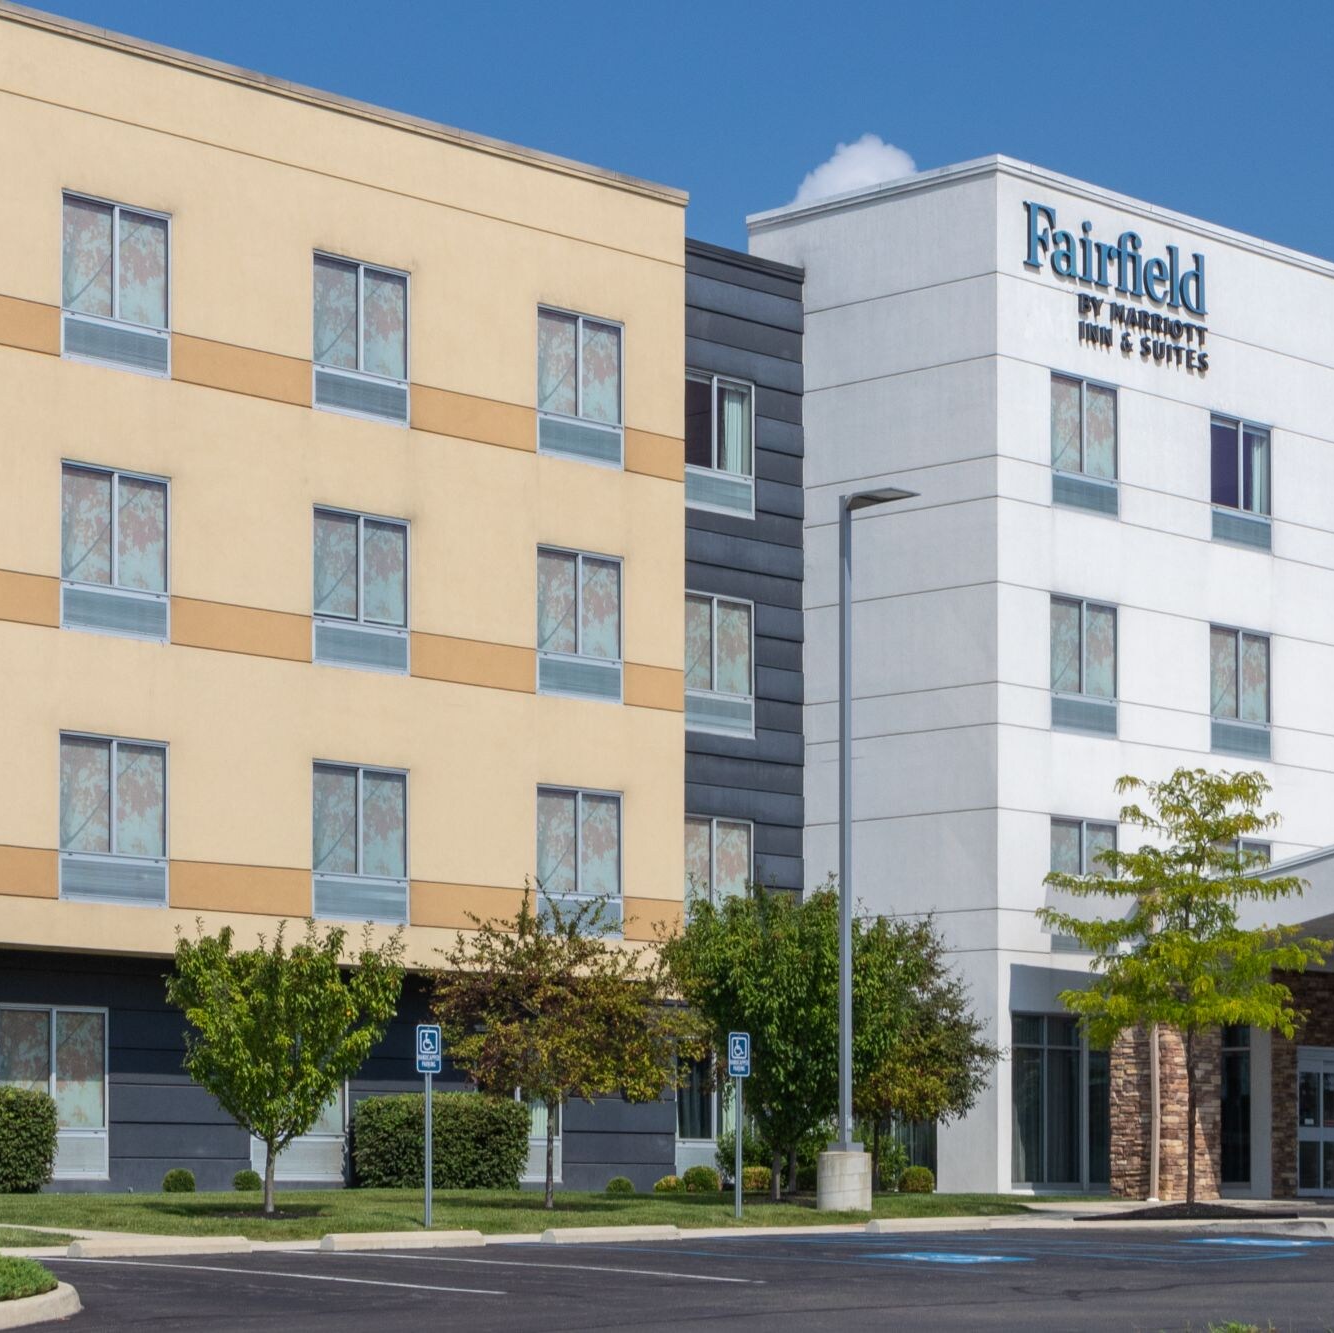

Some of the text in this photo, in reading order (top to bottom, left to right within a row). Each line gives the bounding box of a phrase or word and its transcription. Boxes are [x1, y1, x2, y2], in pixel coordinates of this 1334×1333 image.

[1023, 201, 1208, 316] Fairfield
[1078, 293, 1209, 346] BY MARRIOTT
[1078, 320, 1209, 372] INN & SUITES
